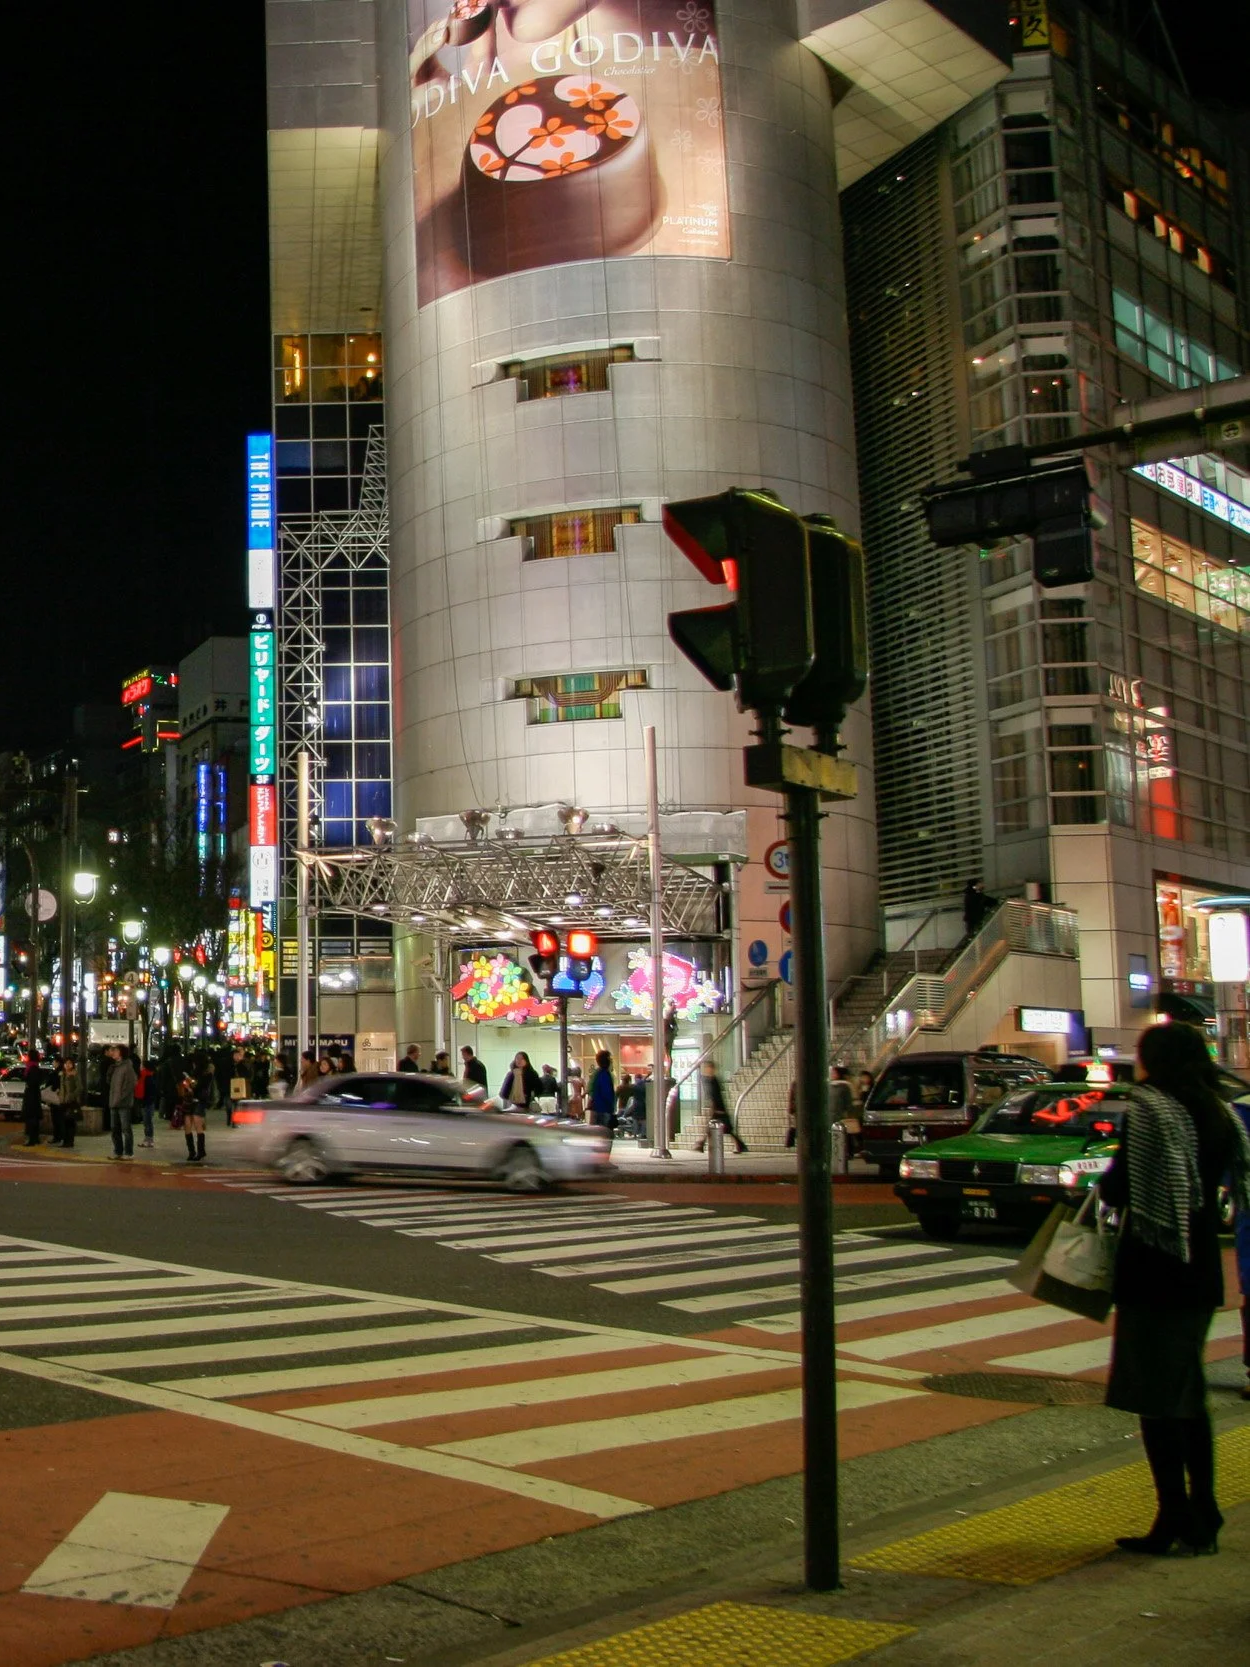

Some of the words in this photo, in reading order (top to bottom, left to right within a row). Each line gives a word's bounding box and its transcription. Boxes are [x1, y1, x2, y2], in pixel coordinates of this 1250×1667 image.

[531, 31, 719, 73] GODIVA
[604, 65, 656, 77] Chocolatier
[662, 216, 718, 227] PLATINUM
[254, 635, 270, 772] ビリヤード・ダーツ
